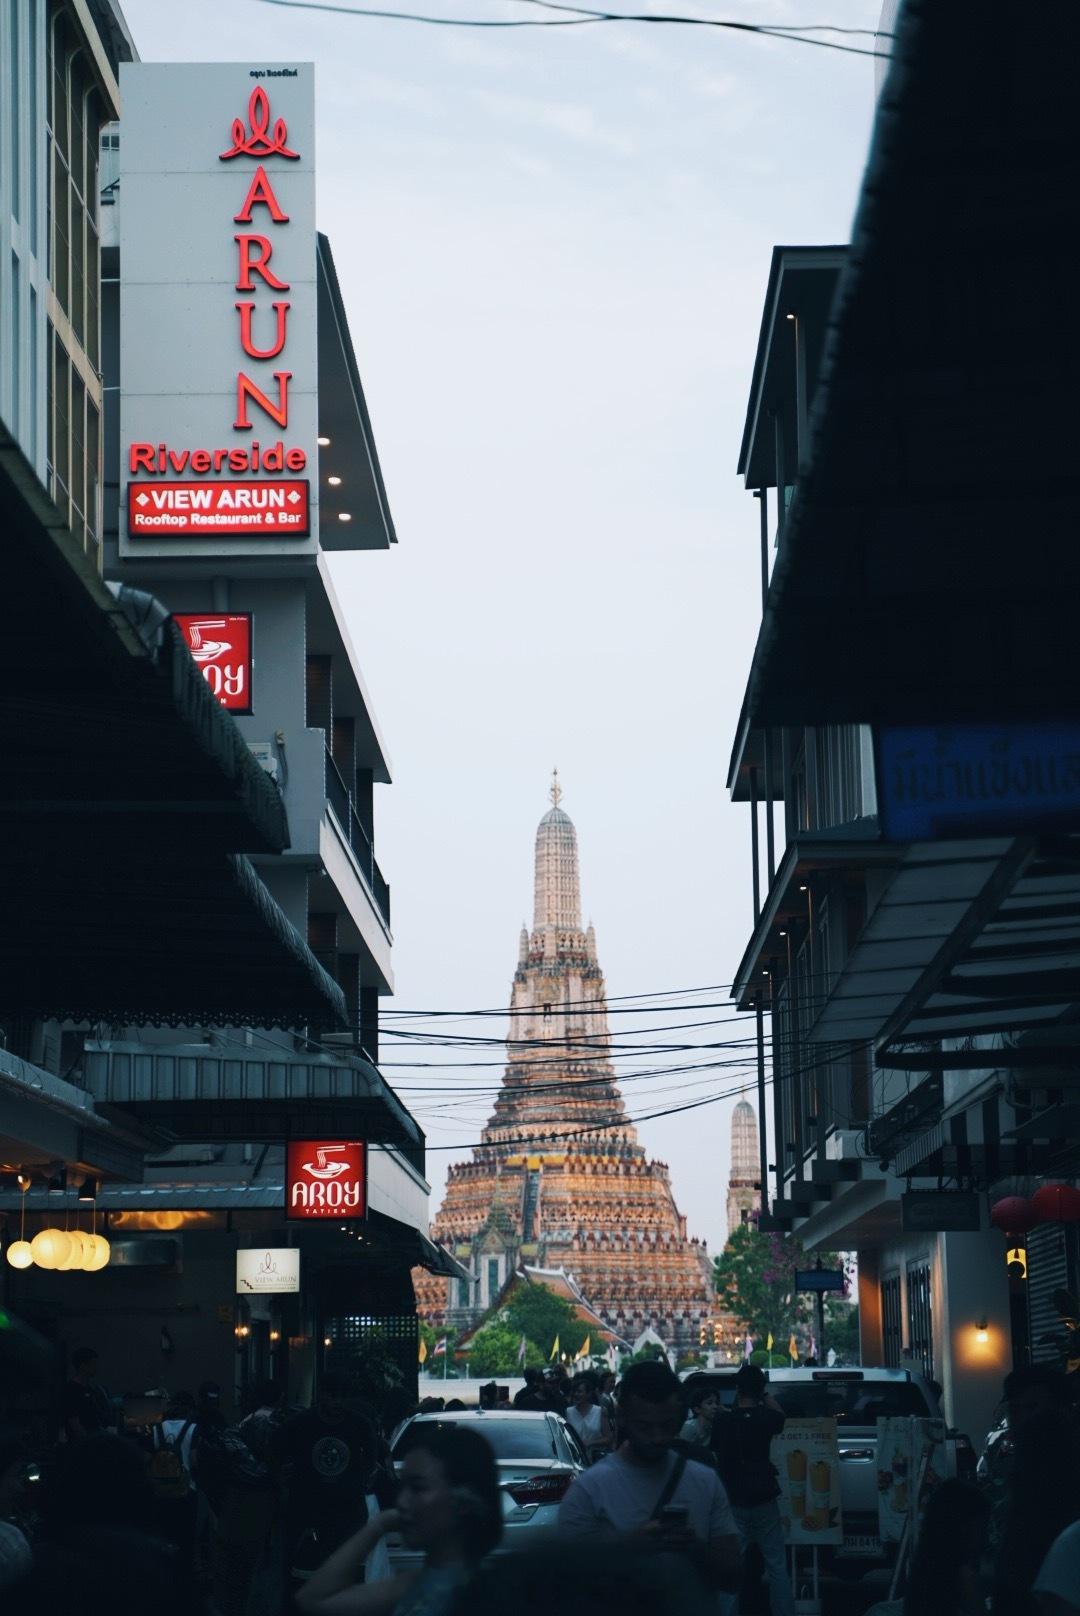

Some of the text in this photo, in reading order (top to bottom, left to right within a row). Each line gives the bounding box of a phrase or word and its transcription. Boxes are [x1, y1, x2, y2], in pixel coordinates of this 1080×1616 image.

[232, 165, 292, 429] ARUN
[129, 441, 306, 474] Riverside
[151, 488, 286, 509] VIEW ARUN
[134, 511, 302, 527] Rooftop Restaurant & Bar
[291, 1181, 360, 1207] AROY
